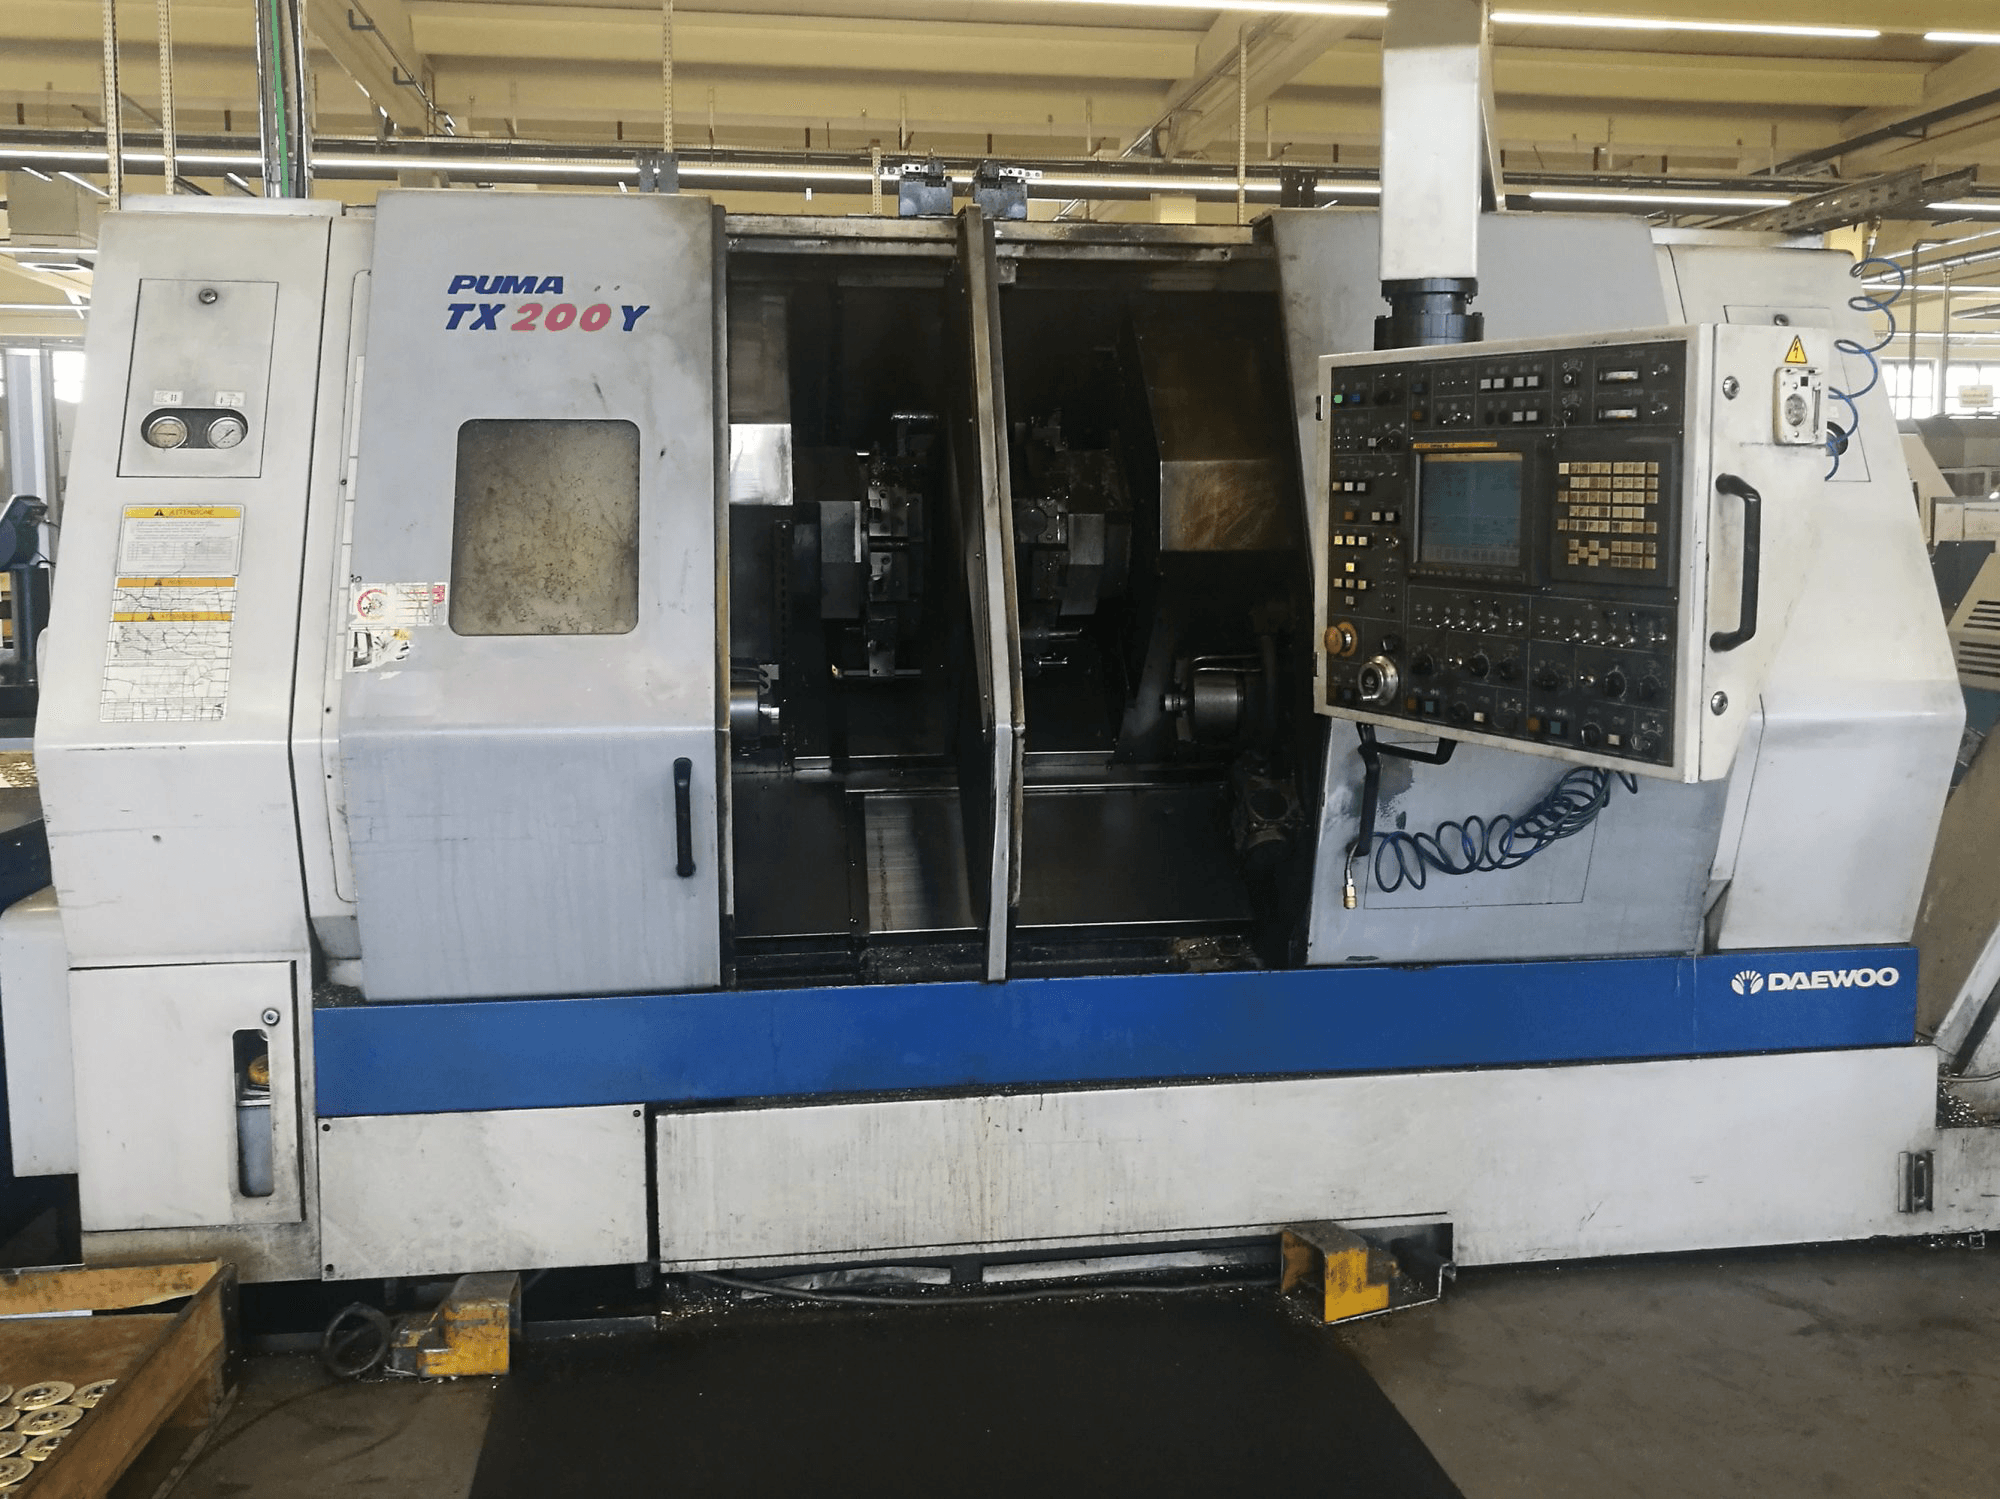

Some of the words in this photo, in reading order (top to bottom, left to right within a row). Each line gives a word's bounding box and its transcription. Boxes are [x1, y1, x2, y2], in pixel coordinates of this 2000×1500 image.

[447, 275, 564, 295] PUMA
[510, 302, 612, 333] 200
[1768, 967, 1899, 992] DAEWOO
